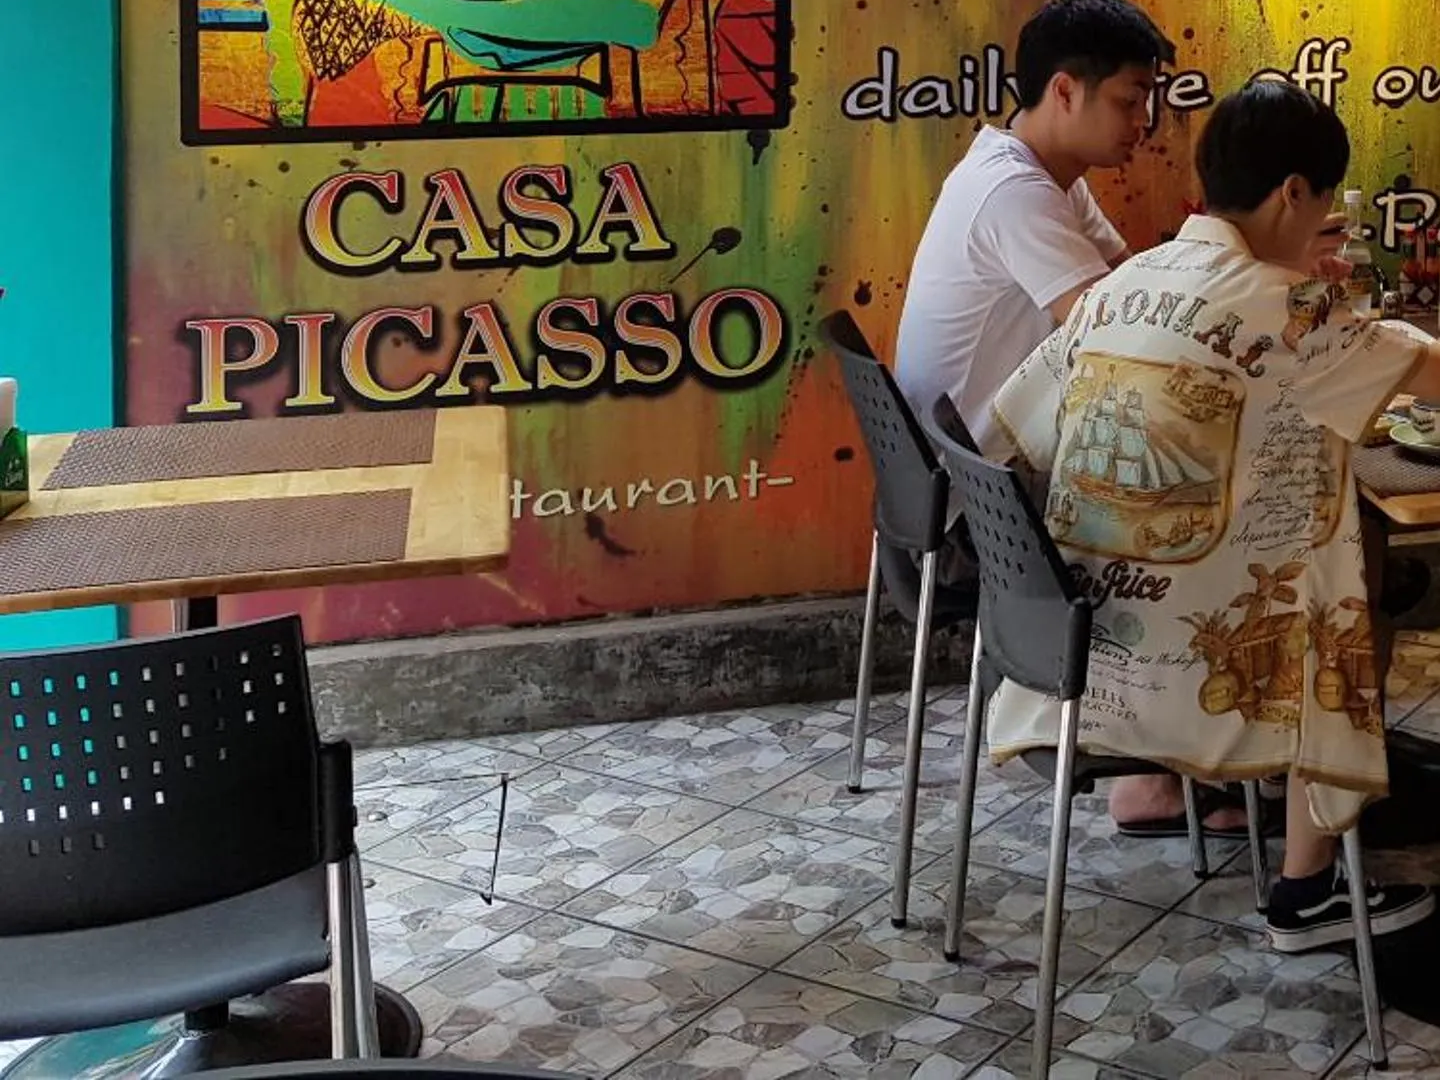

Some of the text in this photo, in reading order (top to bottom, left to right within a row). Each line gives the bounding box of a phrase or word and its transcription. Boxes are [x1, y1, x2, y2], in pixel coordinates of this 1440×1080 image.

[1249, 37, 1351, 108] ff
[302, 162, 676, 270] CASA
[184, 287, 784, 414] PICASSO
